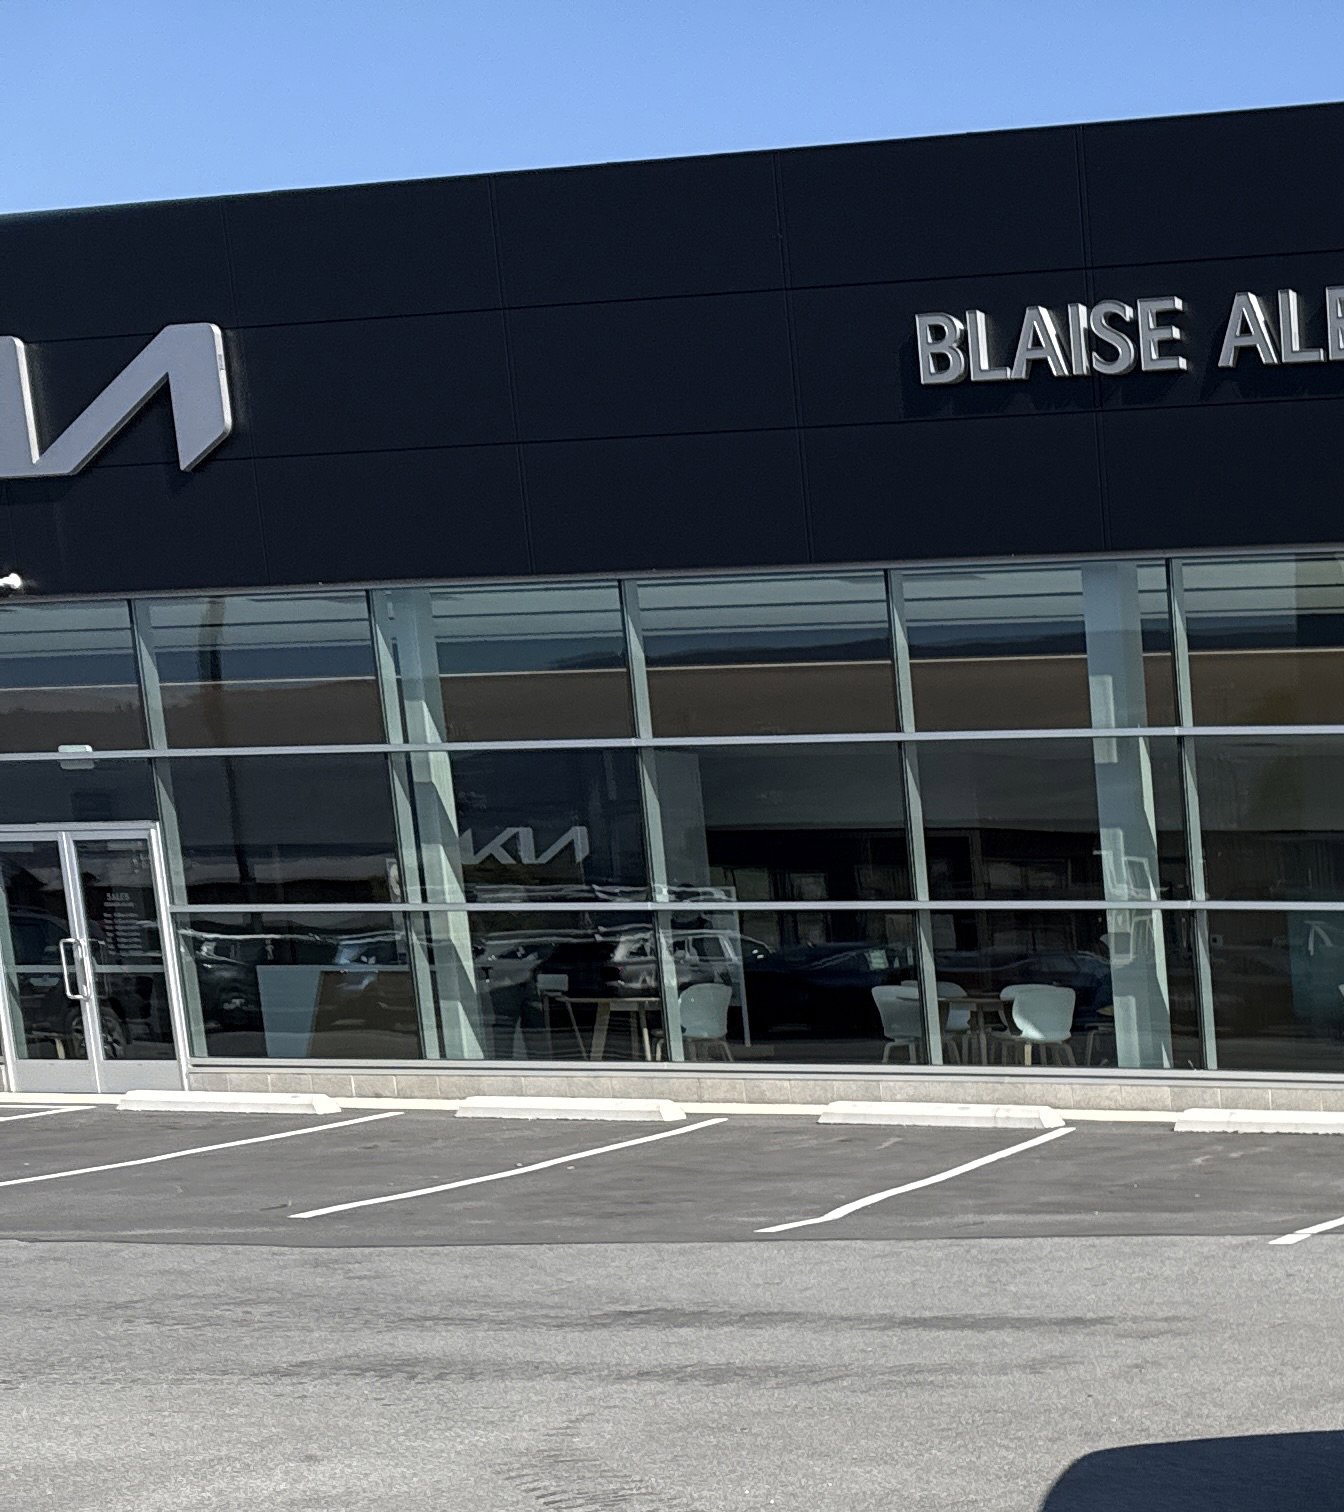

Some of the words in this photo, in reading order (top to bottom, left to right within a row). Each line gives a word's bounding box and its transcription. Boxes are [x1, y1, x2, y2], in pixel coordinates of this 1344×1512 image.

[914, 296, 1188, 385] BLAISE
[0, 321, 233, 478] IA
[459, 826, 590, 864] KIA
